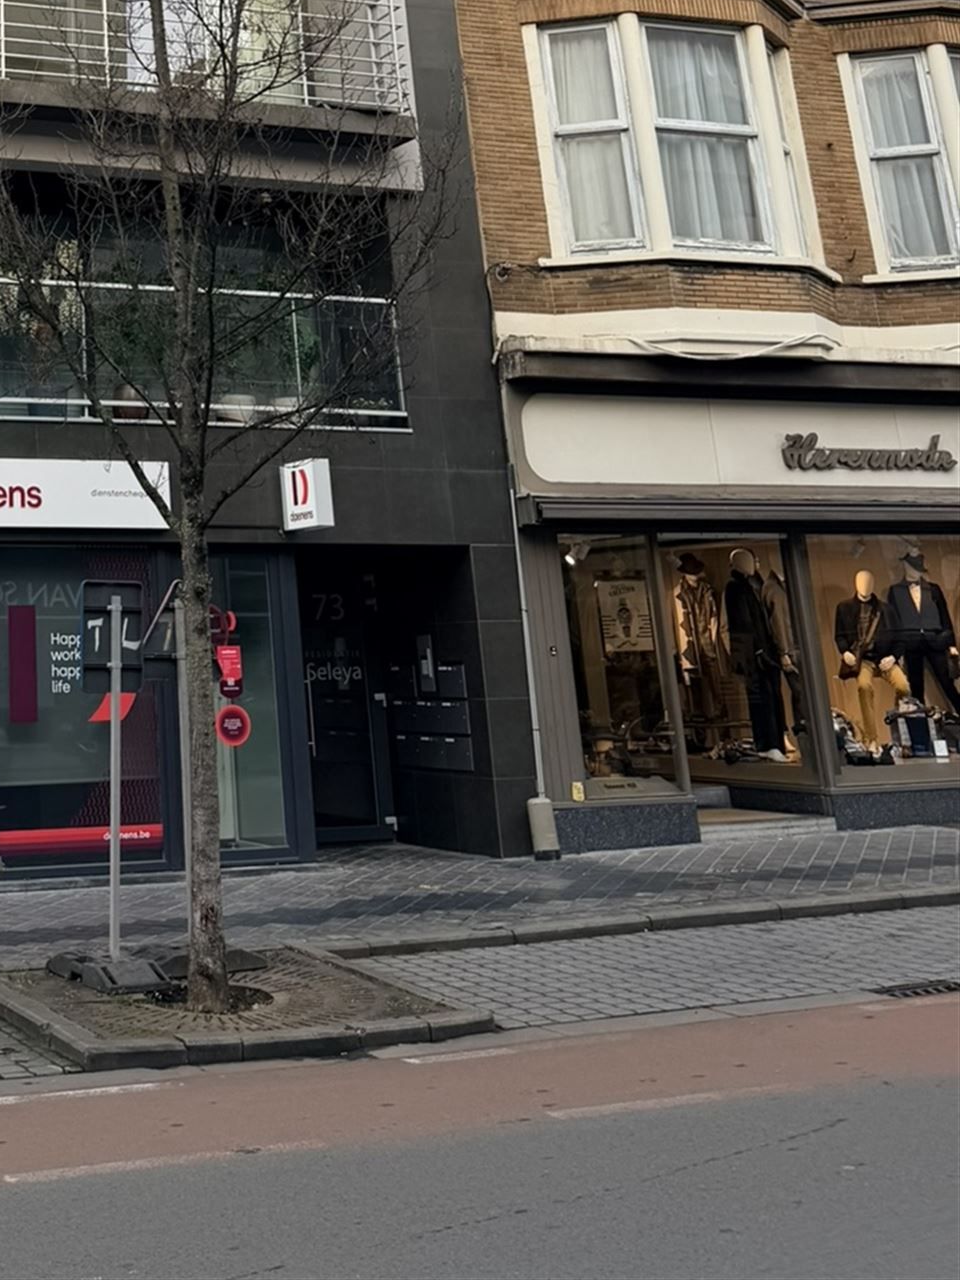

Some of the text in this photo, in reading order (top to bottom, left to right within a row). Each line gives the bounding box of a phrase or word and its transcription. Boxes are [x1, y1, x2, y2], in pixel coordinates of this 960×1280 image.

[312, 593, 345, 620] 73
[50, 647, 81, 661] work
[51, 679, 71, 693] life
